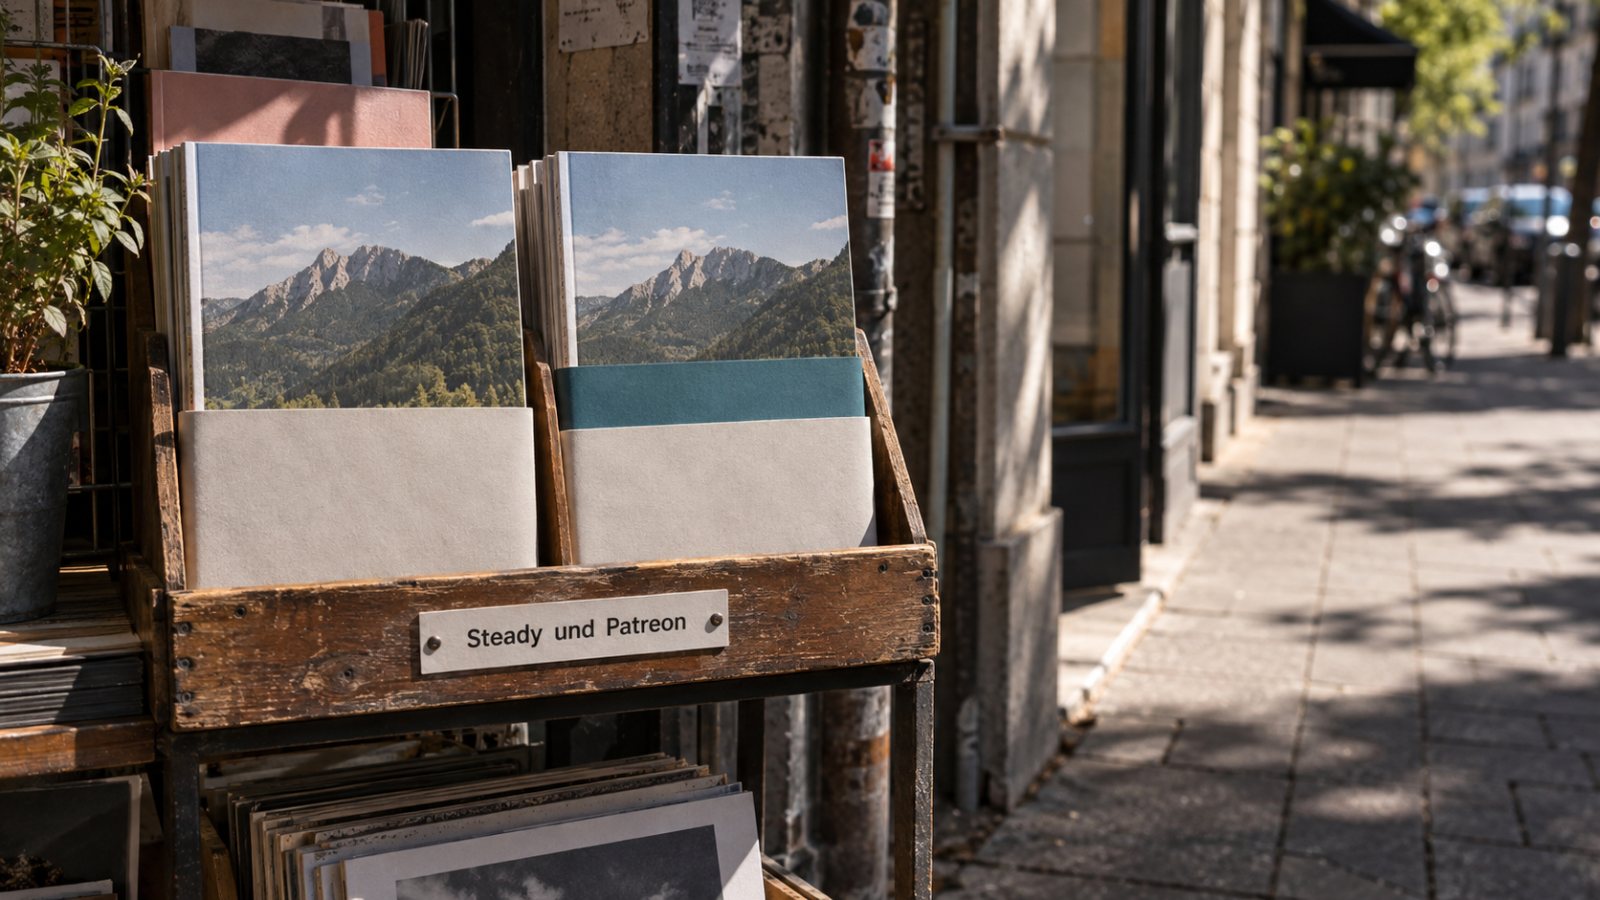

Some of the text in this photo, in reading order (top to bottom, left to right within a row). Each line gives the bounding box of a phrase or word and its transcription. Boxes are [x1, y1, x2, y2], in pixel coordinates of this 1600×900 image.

[467, 616, 687, 648] Steady und Patreon
